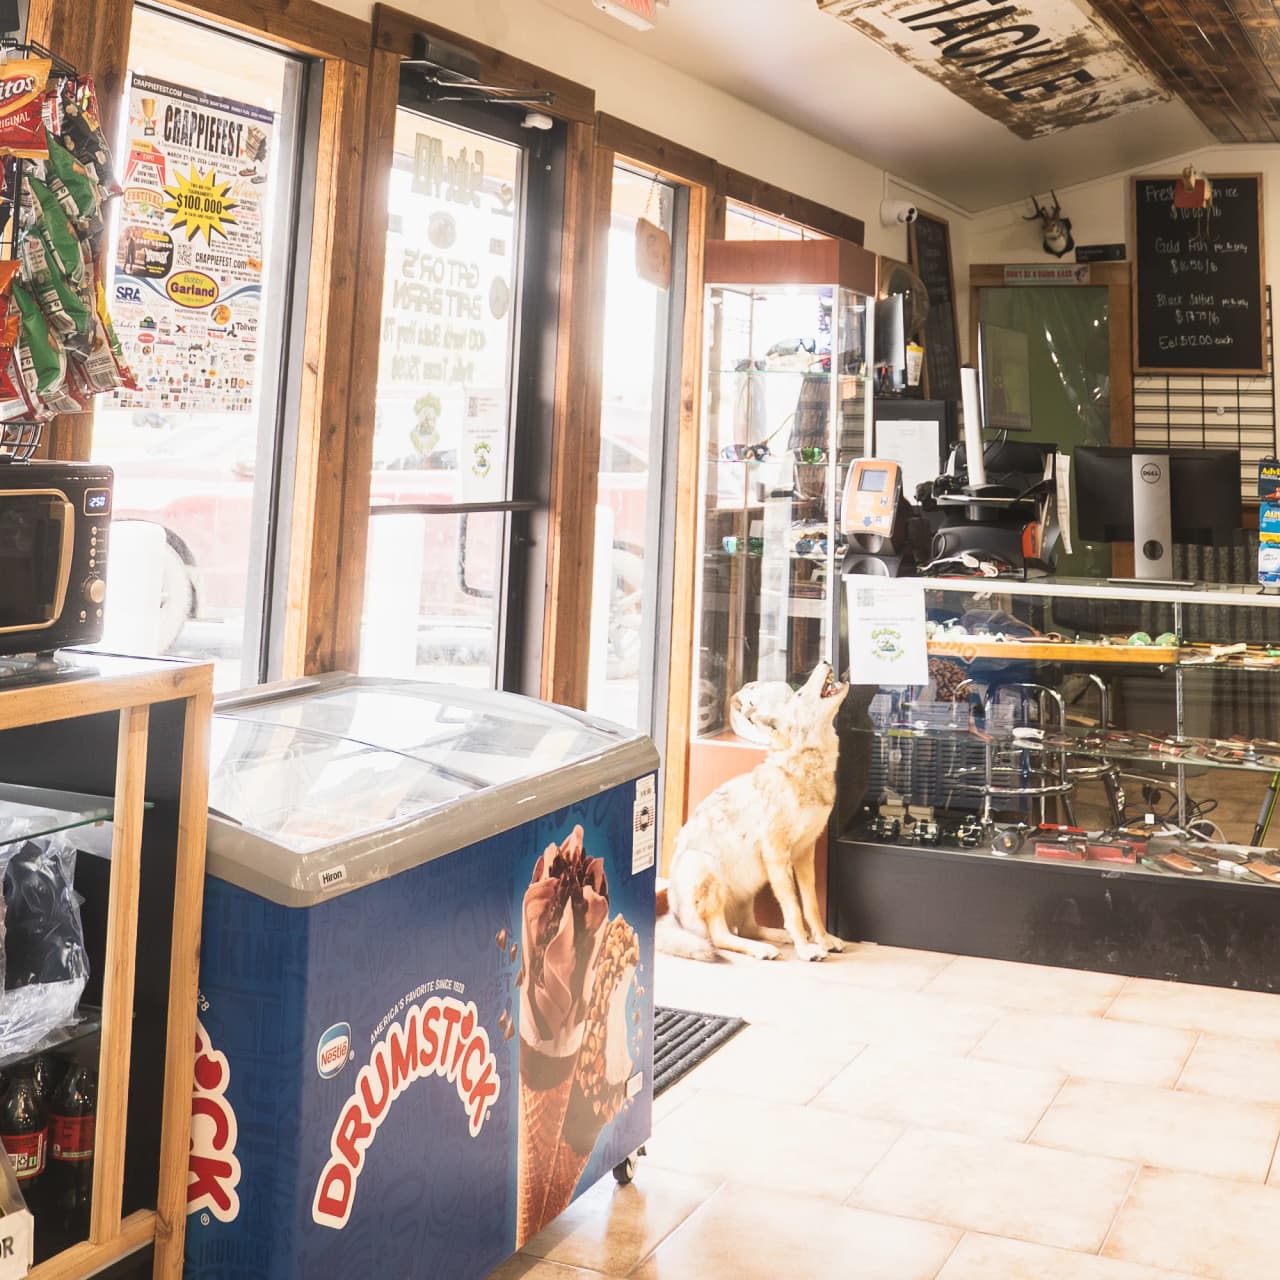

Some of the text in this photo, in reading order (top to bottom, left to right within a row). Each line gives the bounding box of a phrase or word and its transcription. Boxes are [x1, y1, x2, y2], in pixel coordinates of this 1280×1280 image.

[163, 104, 243, 158] CRAPPIEFEST
[176, 193, 223, 215] $100,000
[170, 282, 215, 298] Garland
[322, 870, 343, 885] Hiron
[370, 1001, 405, 1044] AMERICA'S
[404, 978, 436, 1004] FAVORITE
[435, 978, 453, 992] SINCE
